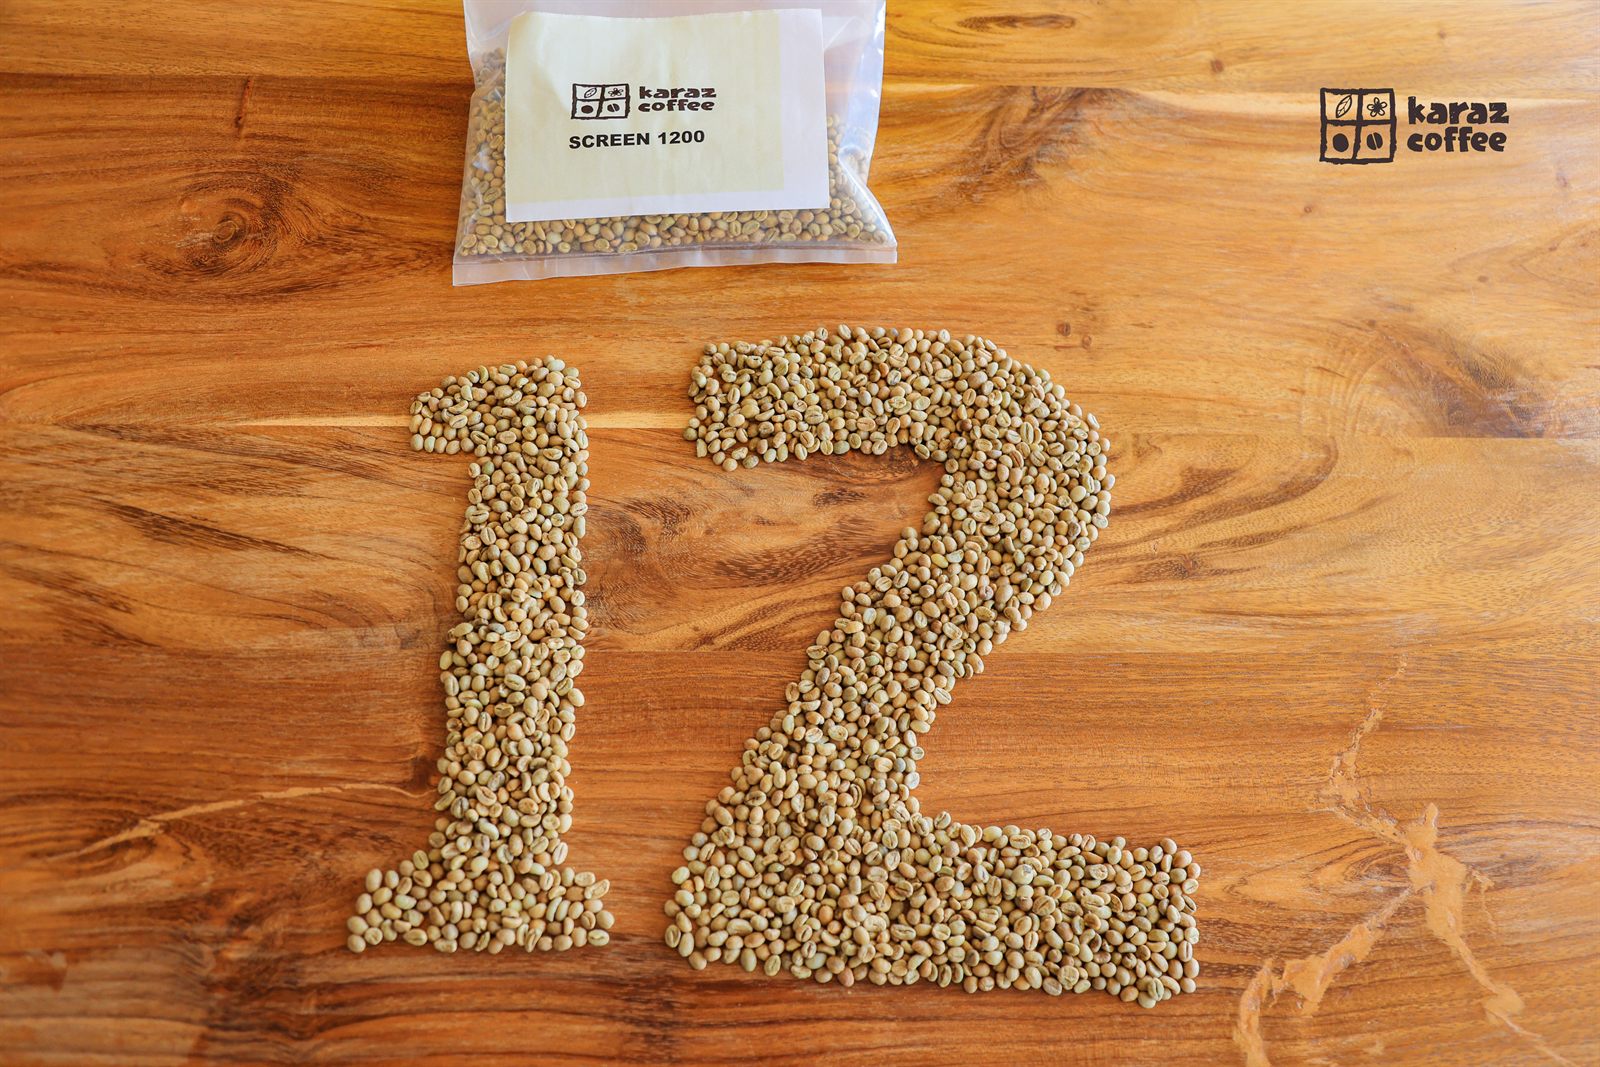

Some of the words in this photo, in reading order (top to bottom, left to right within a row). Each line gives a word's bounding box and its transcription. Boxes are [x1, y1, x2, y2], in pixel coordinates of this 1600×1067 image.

[638, 86, 717, 99] karaz
[637, 98, 715, 113] coffee
[569, 132, 650, 150] SCREEN
[657, 130, 705, 145] 1200
[347, 323, 1202, 1009] 12
